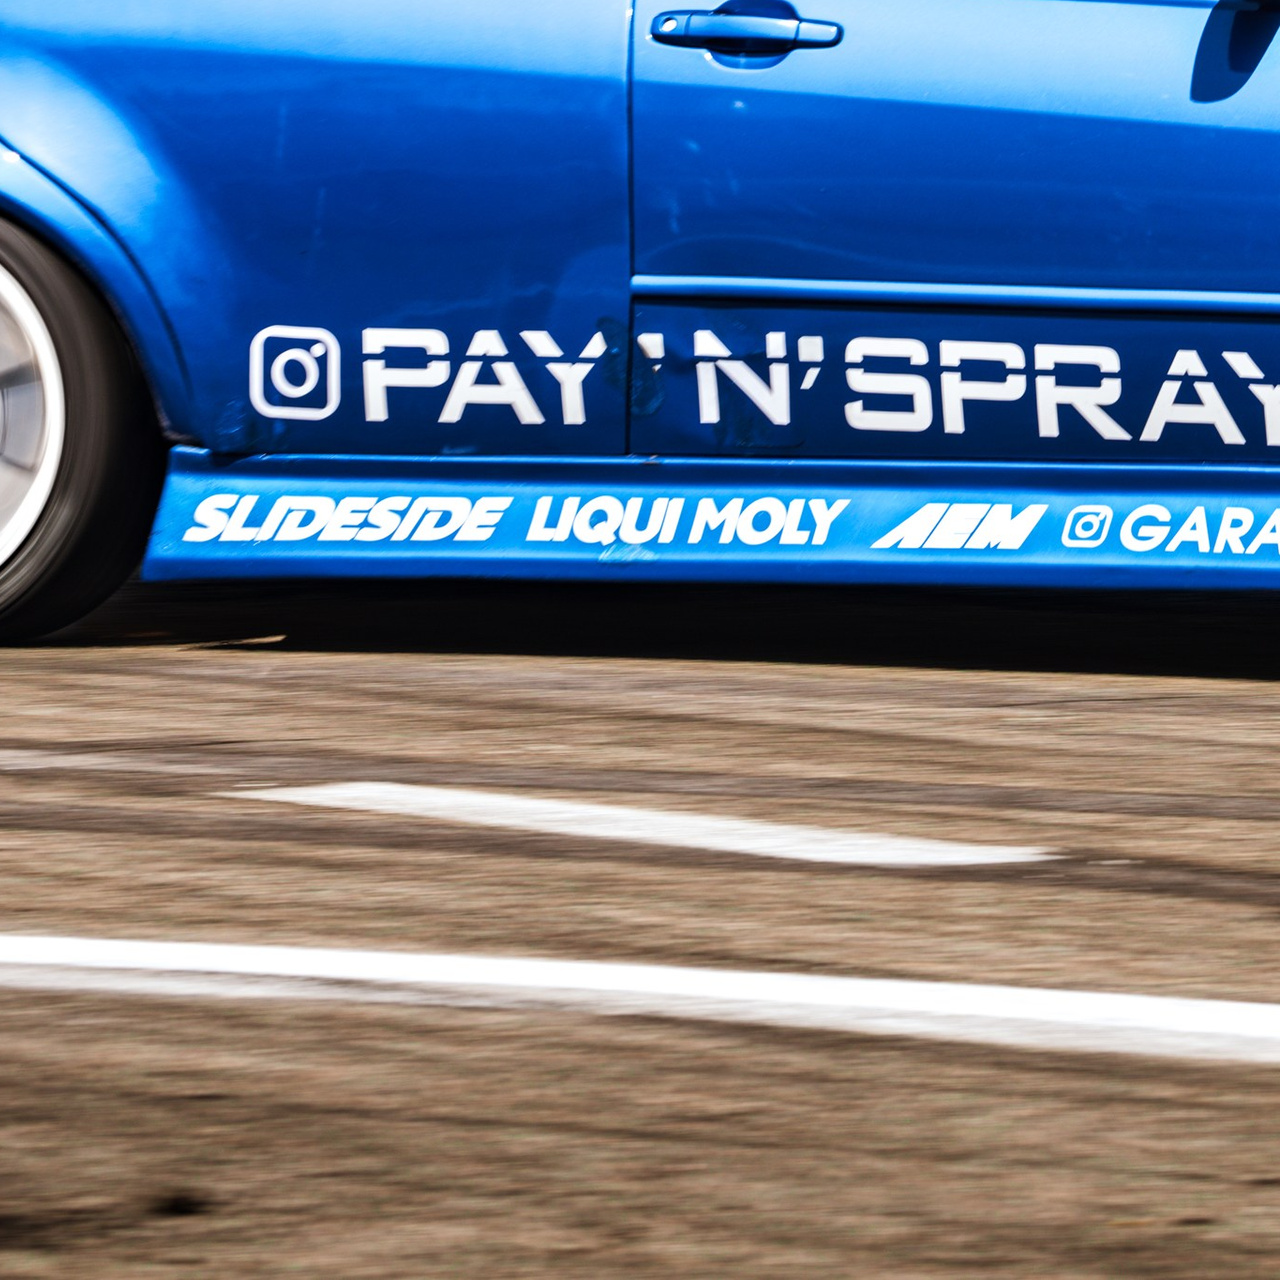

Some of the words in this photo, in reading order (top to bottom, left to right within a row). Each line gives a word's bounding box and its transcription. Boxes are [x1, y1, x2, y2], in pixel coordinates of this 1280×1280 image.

[362, 328, 607, 424] PAY
[183, 494, 513, 542] SLIDESIDE
[526, 496, 684, 545] LIQUI
[688, 497, 851, 545] MOLY
